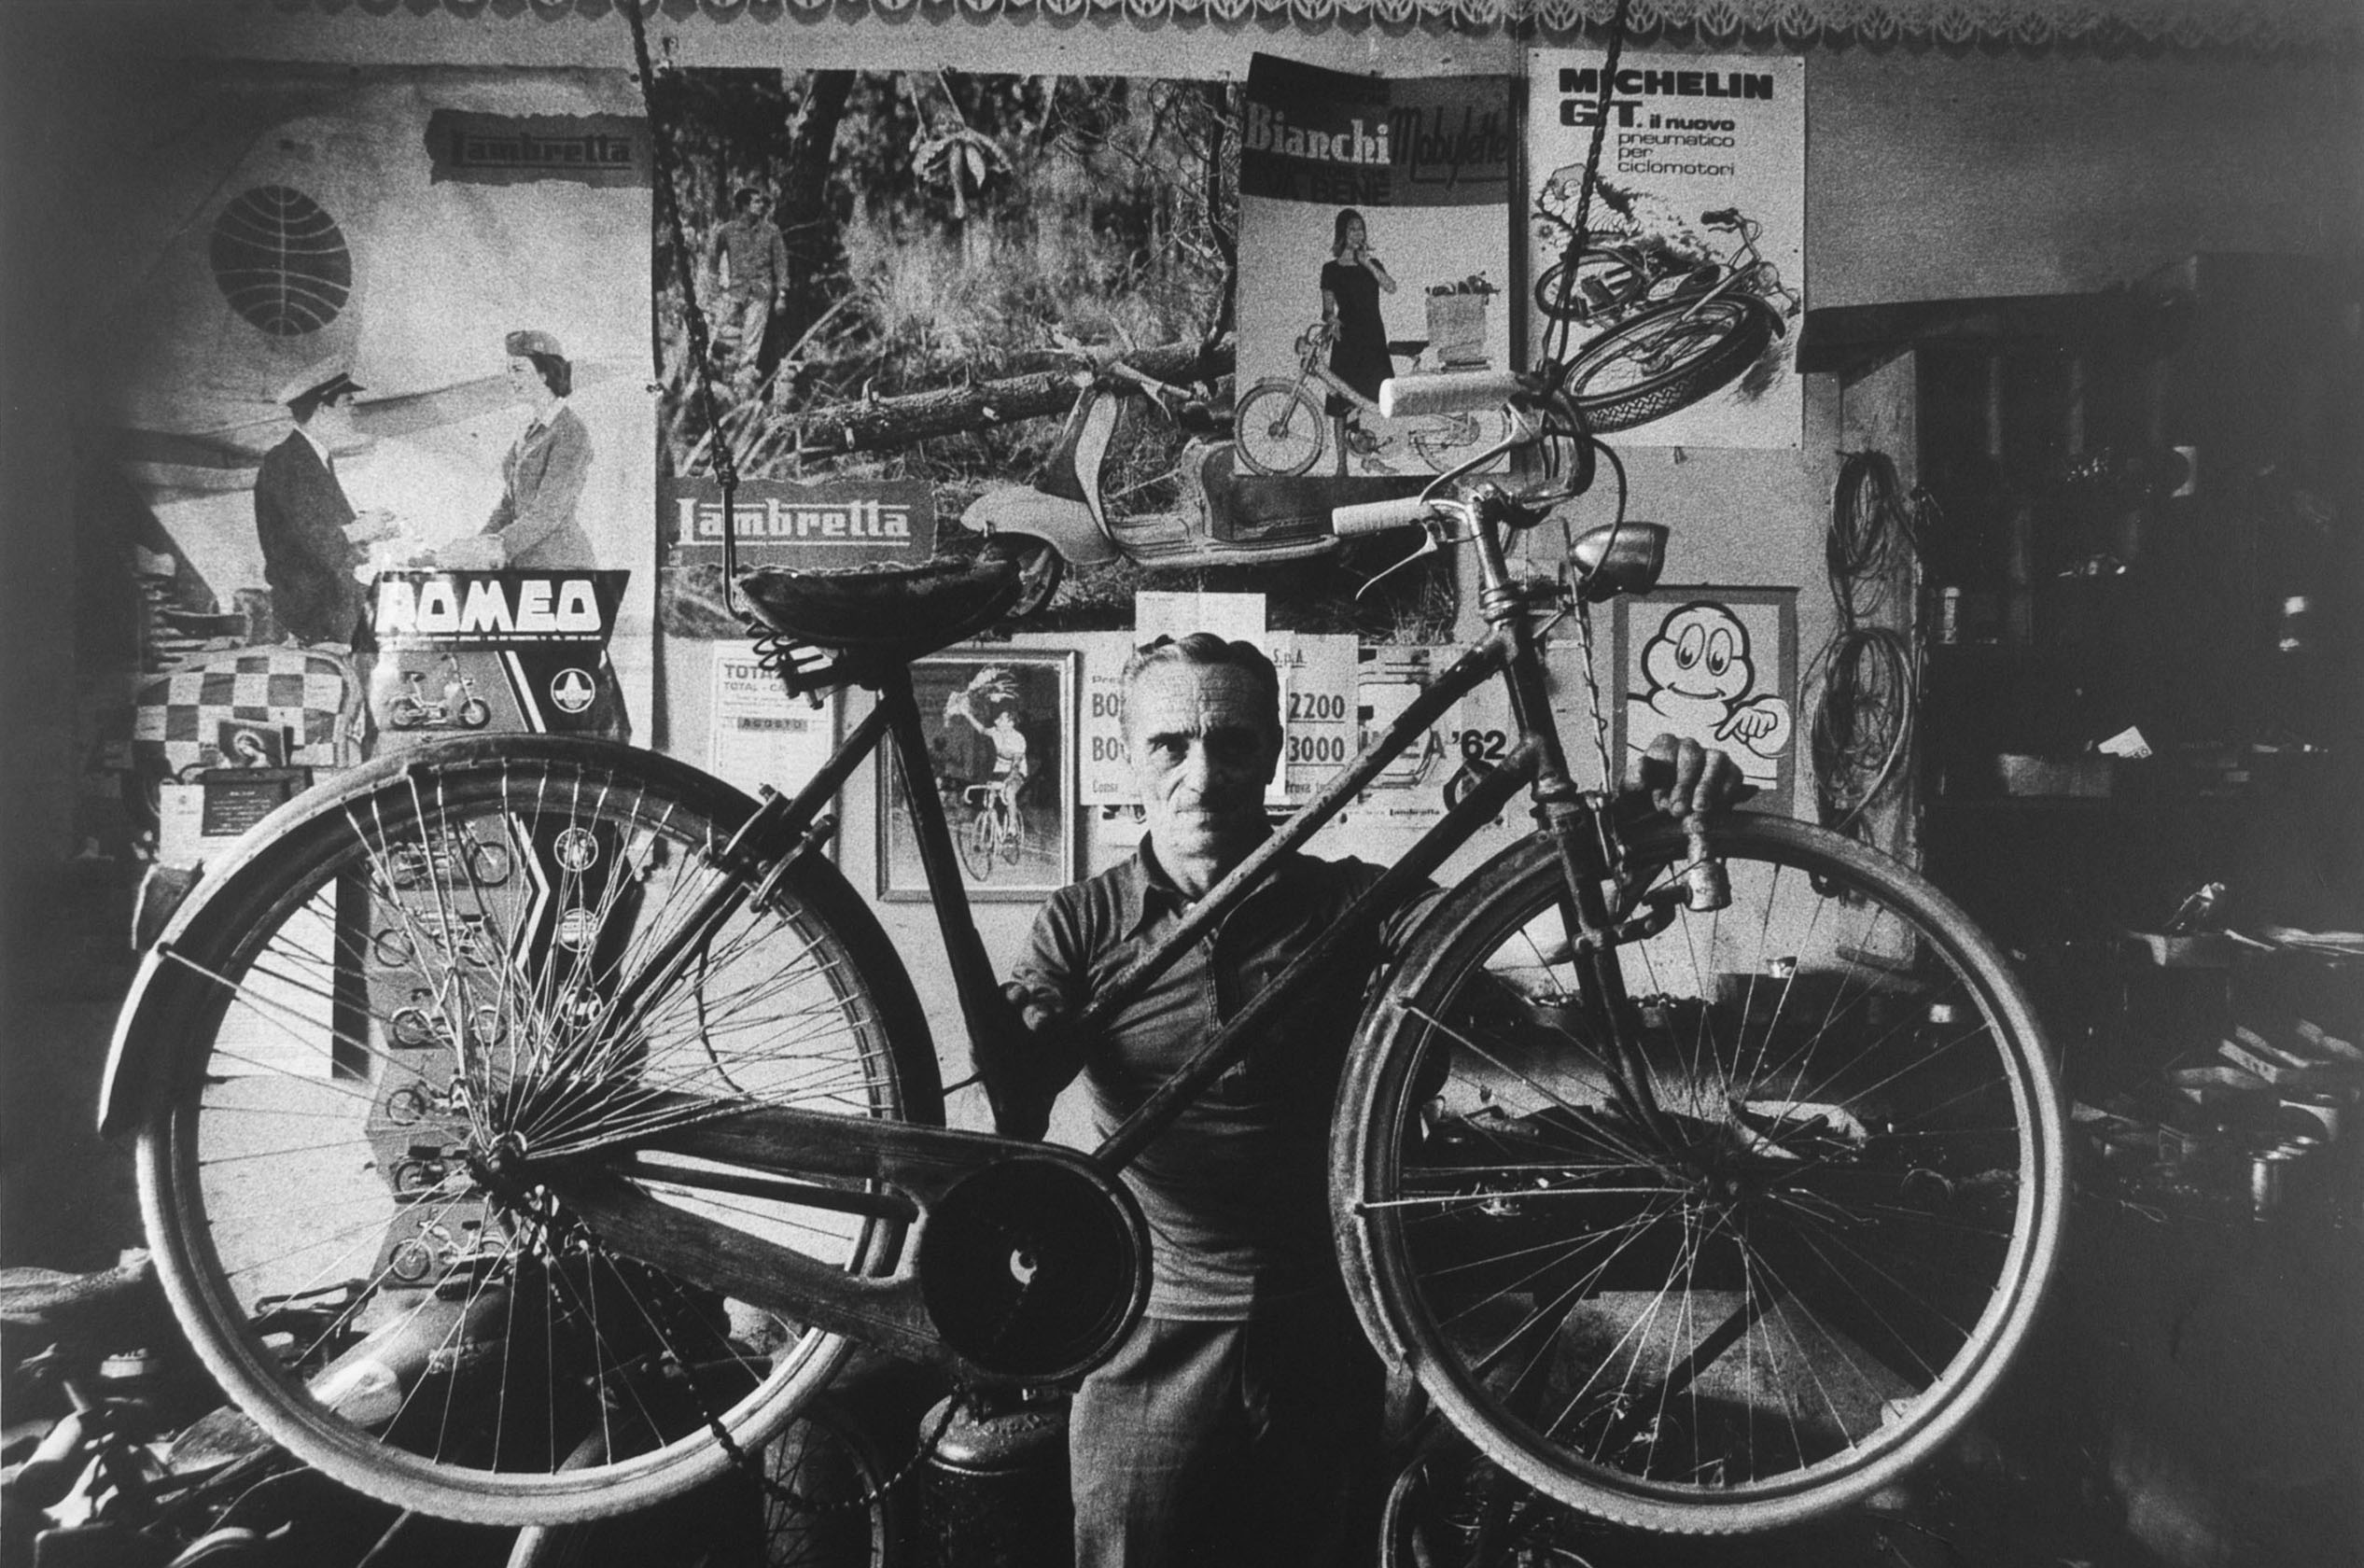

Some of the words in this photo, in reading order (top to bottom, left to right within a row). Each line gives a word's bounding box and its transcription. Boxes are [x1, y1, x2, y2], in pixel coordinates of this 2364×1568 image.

[1649, 114, 1661, 130] il
[1665, 117, 1736, 132] nuovo
[1244, 100, 1392, 165] Bianchi
[1617, 133, 1736, 147] pneumatico
[1617, 147, 1654, 161] per
[1617, 160, 1735, 176] ciclomotori
[676, 497, 911, 546] Lambretta
[375, 579, 602, 632] ROMEO
[724, 664, 774, 679] TOTA
[1289, 692, 1346, 720] 2200
[743, 718, 803, 729] AGOSTO
[1289, 735, 1346, 763] 3000
